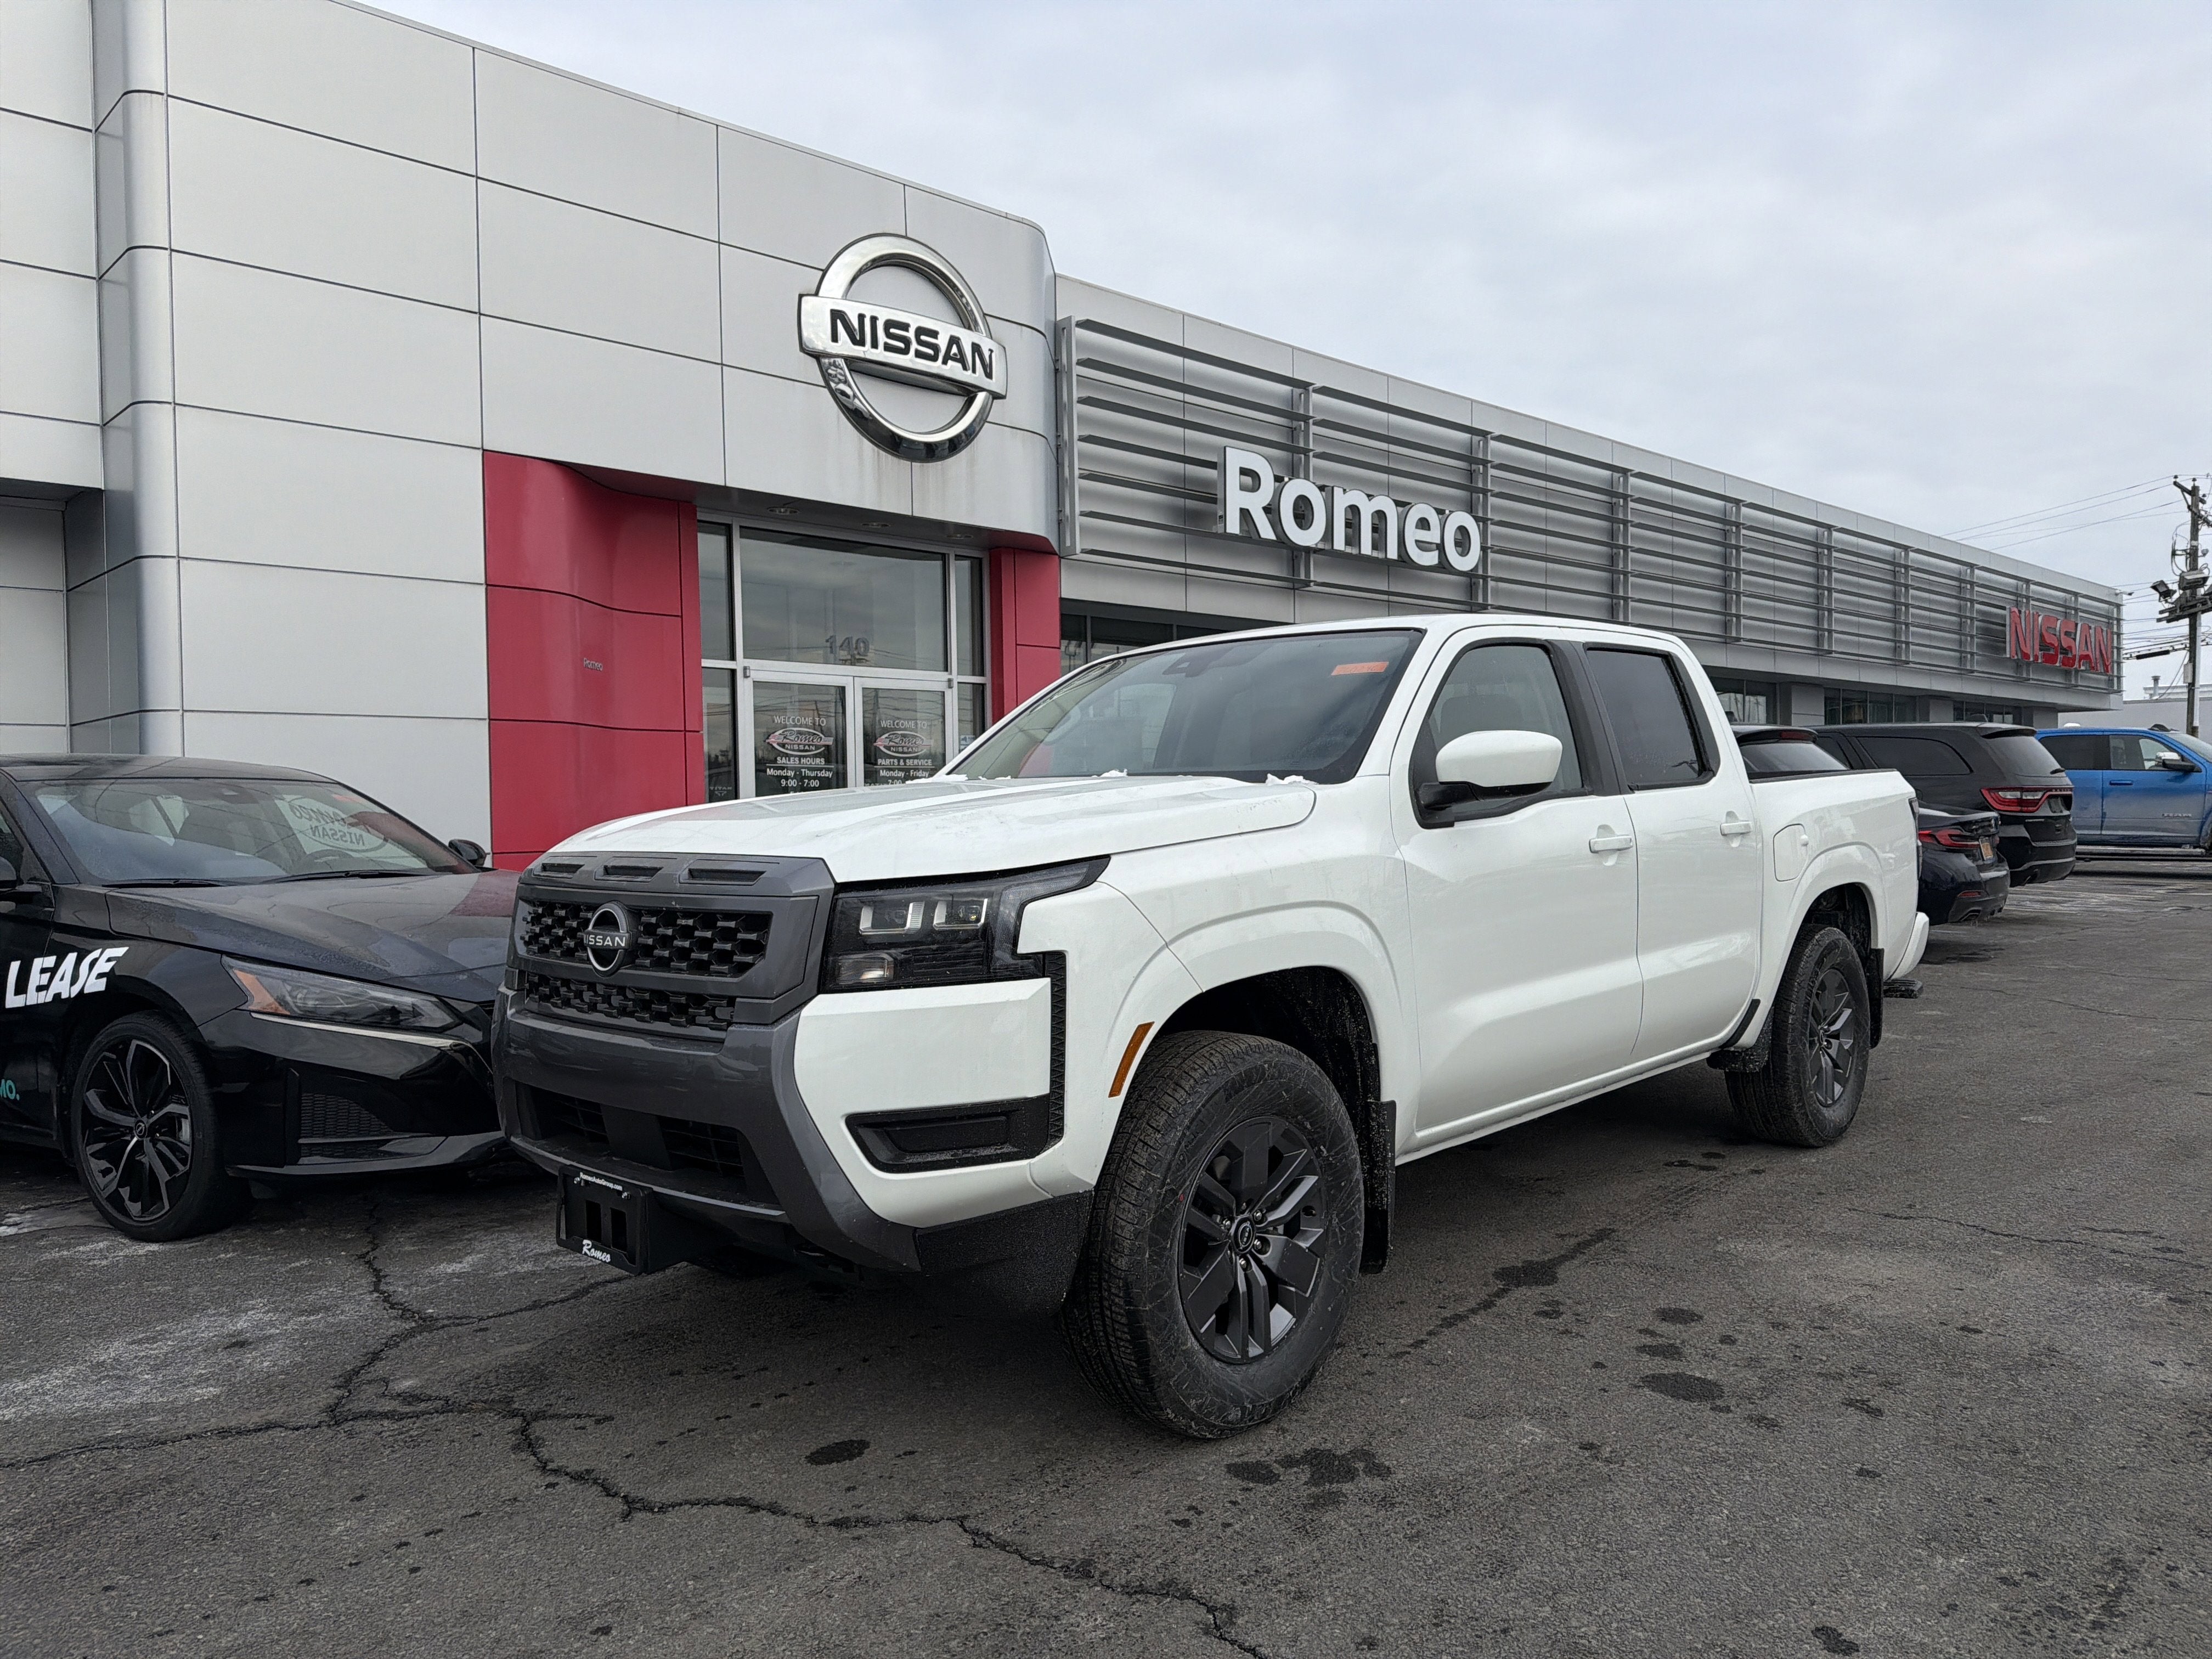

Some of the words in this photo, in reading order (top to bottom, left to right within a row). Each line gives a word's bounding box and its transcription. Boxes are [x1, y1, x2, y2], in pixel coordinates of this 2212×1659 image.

[830, 308, 994, 381] NISSAN
[1223, 445, 1481, 572] Romeo
[825, 635, 870, 657] 140
[2009, 606, 2112, 674] NISSAN
[583, 657, 603, 672] Romeo
[774, 715, 813, 725] WELCOME
[815, 718, 826, 726] TO
[881, 720, 916, 729] WELCOME
[917, 720, 927, 729] TO
[781, 729, 823, 743] Romeo
[766, 768, 795, 777] Monday
[800, 769, 833, 778] Thursday
[880, 770, 905, 778] Monday
[5, 947, 129, 1008] LEASE
[580, 1172, 623, 1191] RomeoAutoGroup.com
[582, 1240, 611, 1262] Romeo
